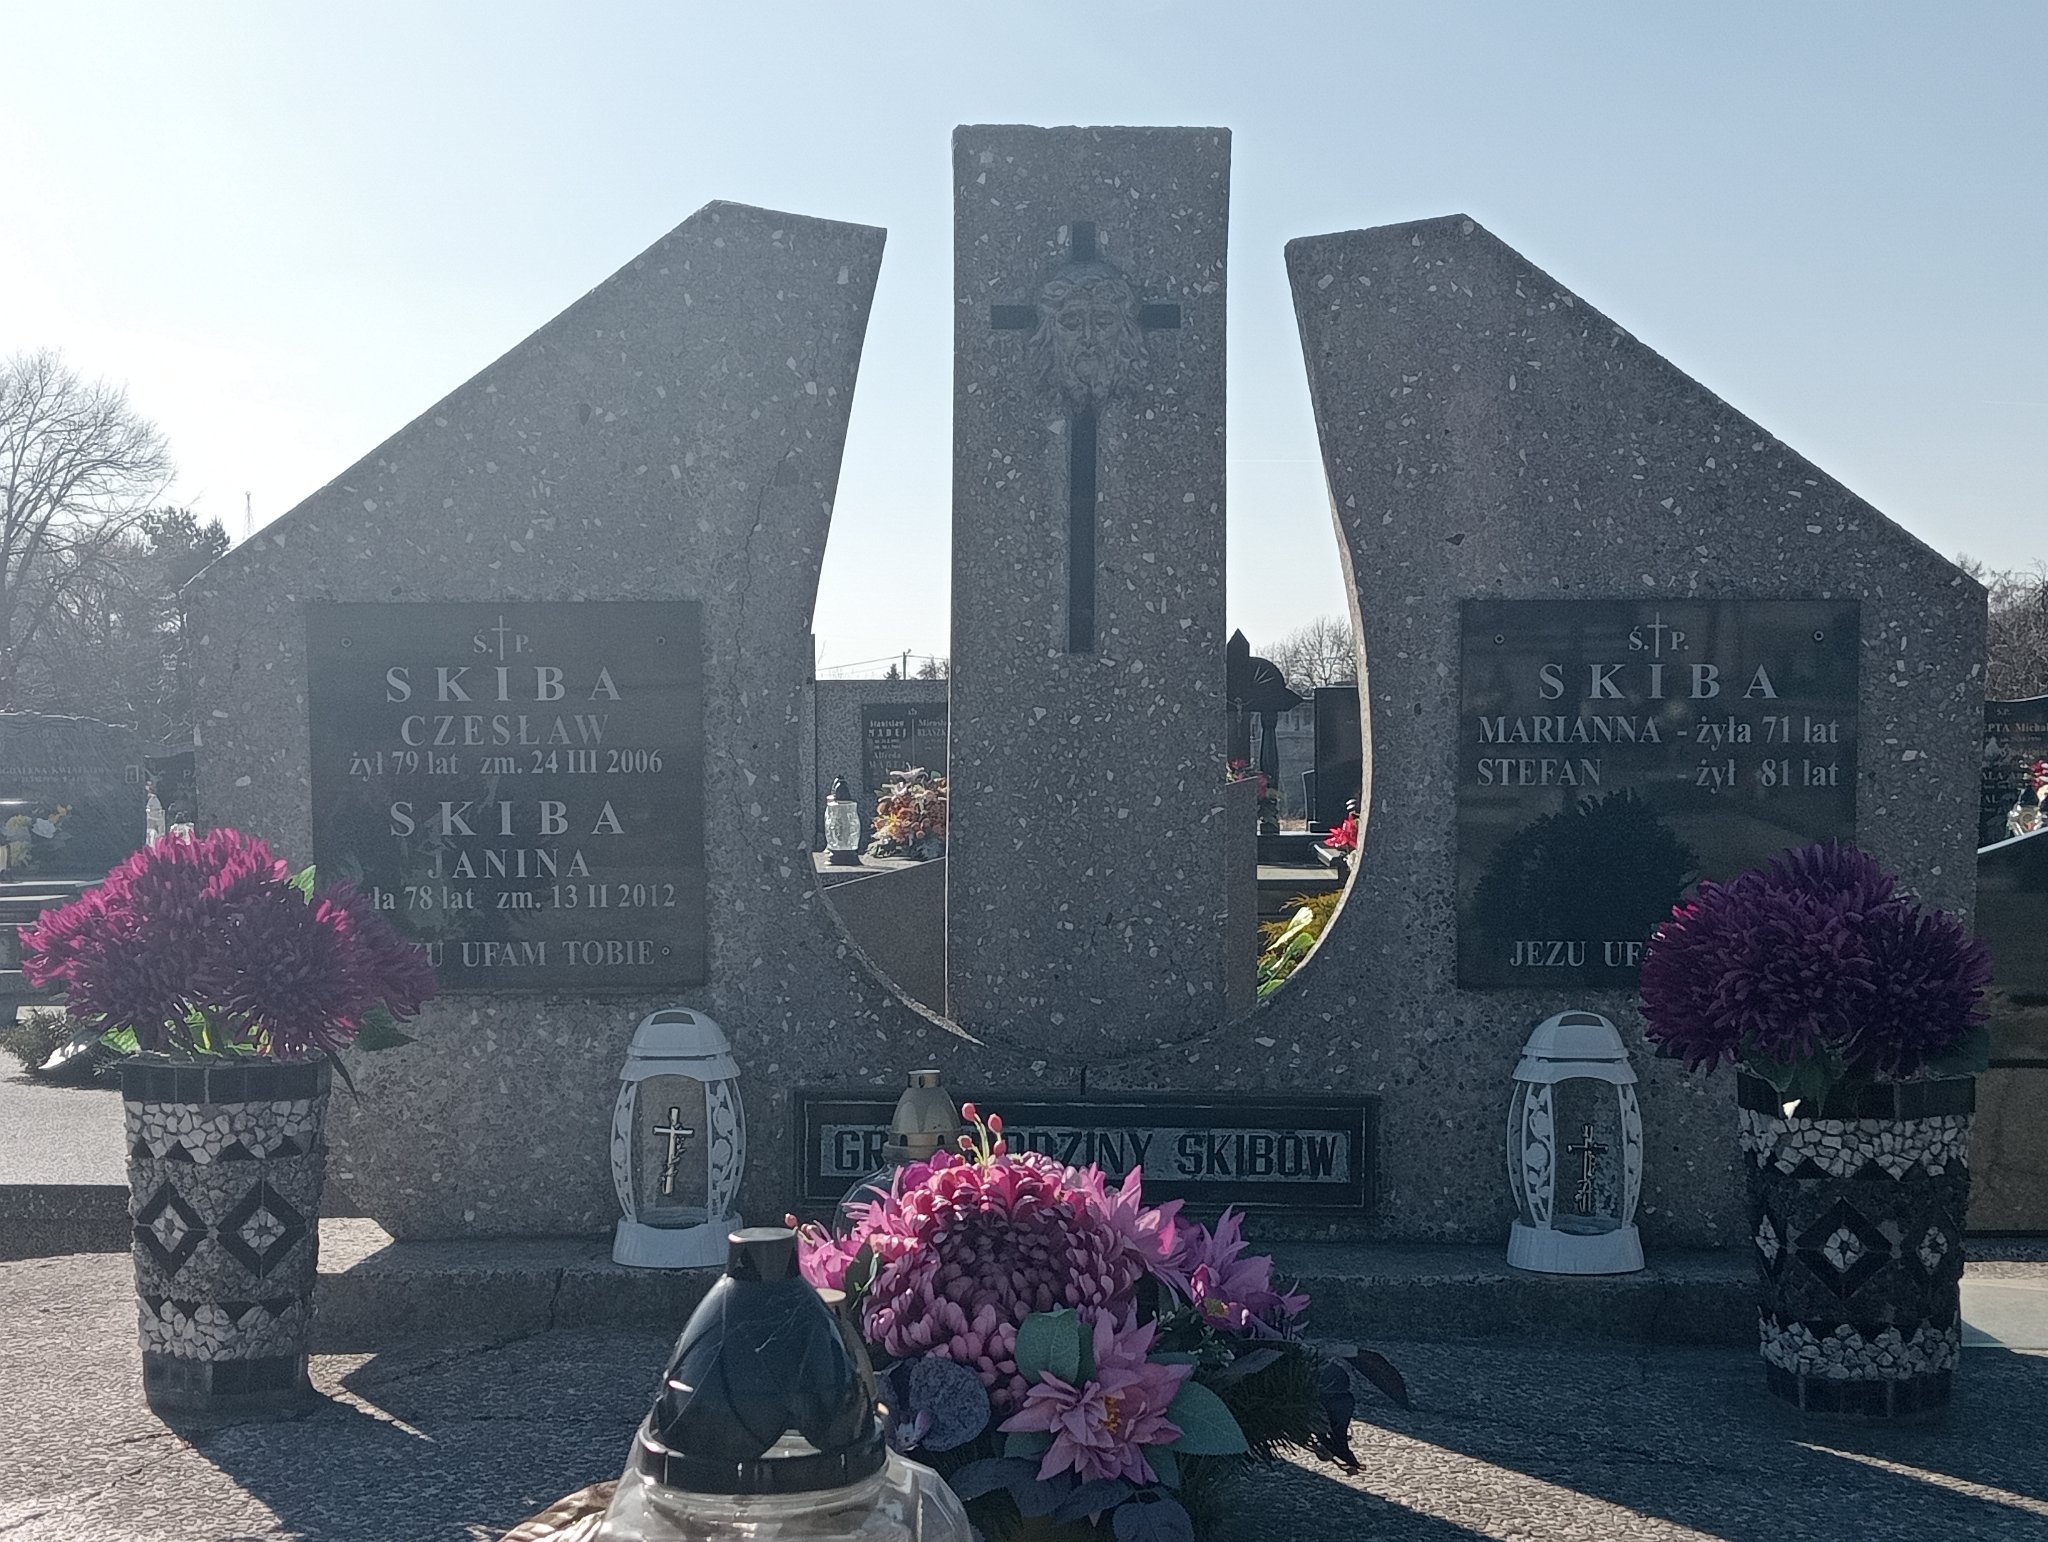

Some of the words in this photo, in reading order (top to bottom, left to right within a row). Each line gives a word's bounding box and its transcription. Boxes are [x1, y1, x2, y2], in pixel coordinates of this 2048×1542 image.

[386, 666, 622, 703] SKIBA
[1539, 663, 1779, 700] SKIBA
[401, 714, 609, 747] CZESŁAW
[1477, 716, 1662, 744] MARIANNA
[1696, 716, 1752, 751] żyła
[1761, 715, 1790, 744] 71
[1803, 716, 1839, 744] lat
[349, 752, 383, 782] żył
[391, 751, 419, 775] 79
[428, 751, 458, 775] lat
[480, 756, 522, 774] zm.
[531, 750, 559, 774] 24
[567, 750, 598, 774] III
[606, 749, 663, 774] 2006
[1477, 758, 1601, 787] STEFAN
[1696, 758, 1736, 795] żył
[1760, 758, 1790, 787] 81
[1803, 758, 1839, 787] lat
[390, 800, 625, 837] SKIBA
[428, 848, 590, 879] JANINA
[373, 886, 396, 910] ła
[404, 885, 433, 910] 78
[442, 886, 475, 910] lat
[496, 890, 541, 909] zm.
[551, 884, 578, 909] 13
[587, 884, 608, 908] II
[618, 882, 676, 908] 2012
[461, 941, 546, 967] UFAM
[562, 940, 655, 966] TOBIE
[1509, 940, 1586, 968] JEZU
[1603, 940, 1651, 967] UF
